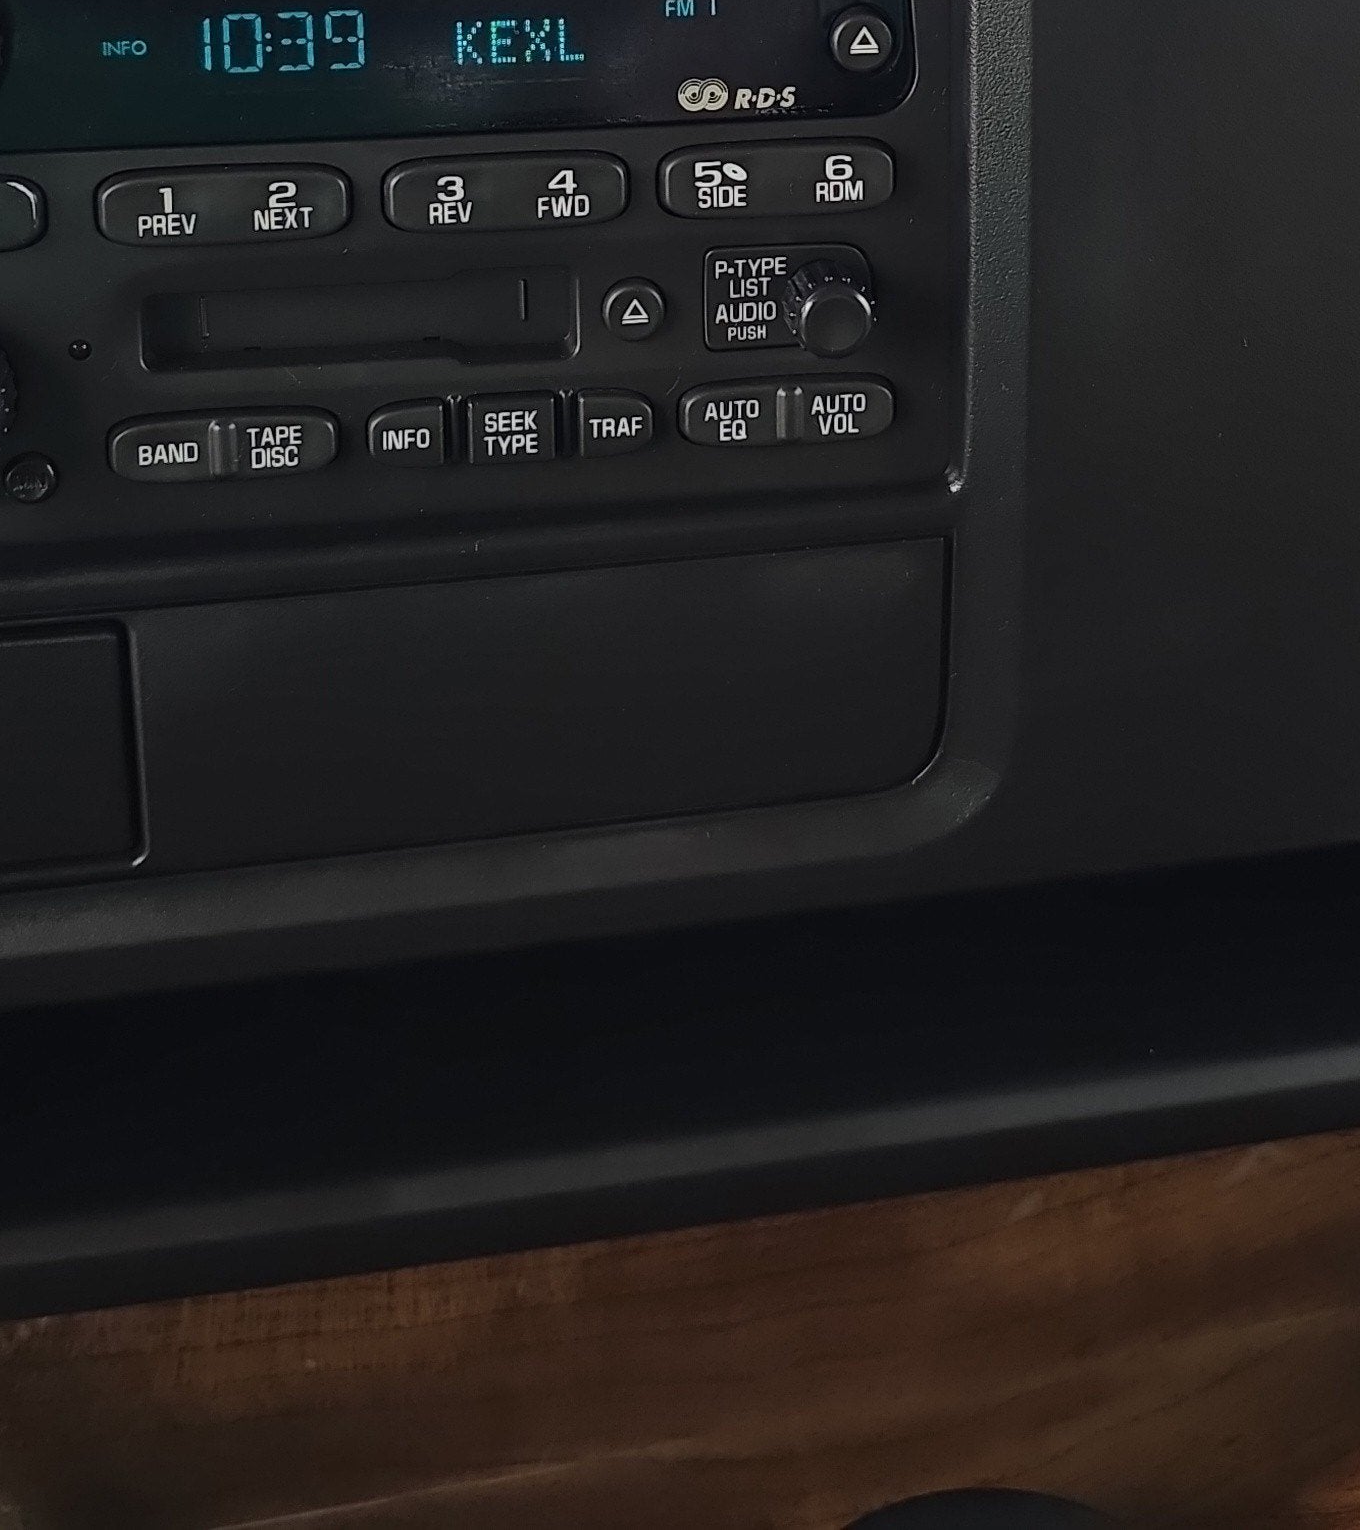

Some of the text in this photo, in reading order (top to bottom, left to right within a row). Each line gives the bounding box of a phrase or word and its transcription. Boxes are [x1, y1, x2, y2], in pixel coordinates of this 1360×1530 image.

[102, 40, 147, 56] INFO
[202, 9, 366, 74] 10:39
[456, 17, 585, 66] KEXL
[694, 160, 722, 189] 5
[825, 154, 853, 181] 6
[268, 181, 298, 208] 2
[436, 175, 465, 203] 3
[547, 169, 579, 197] 4
[815, 179, 864, 203] RDM
[157, 187, 175, 215] 1
[537, 194, 590, 219] FWD
[696, 186, 747, 209] SIDE
[138, 211, 196, 238] PREV
[253, 205, 314, 231] NEXT
[429, 201, 473, 225] REV
[729, 276, 772, 299] LIST
[715, 300, 777, 326] AUDIO
[727, 325, 767, 342] PUSH
[704, 399, 760, 424] AUTO
[811, 393, 866, 417] AUTO
[484, 409, 538, 434] SEEK
[588, 416, 643, 439] TRAF
[719, 419, 747, 442] EQ
[818, 413, 860, 435] VOL
[246, 425, 302, 449] TAPE
[382, 428, 430, 451] INFO
[483, 433, 539, 456] TYPE
[138, 442, 199, 466] BAND
[251, 446, 299, 469] DISC
